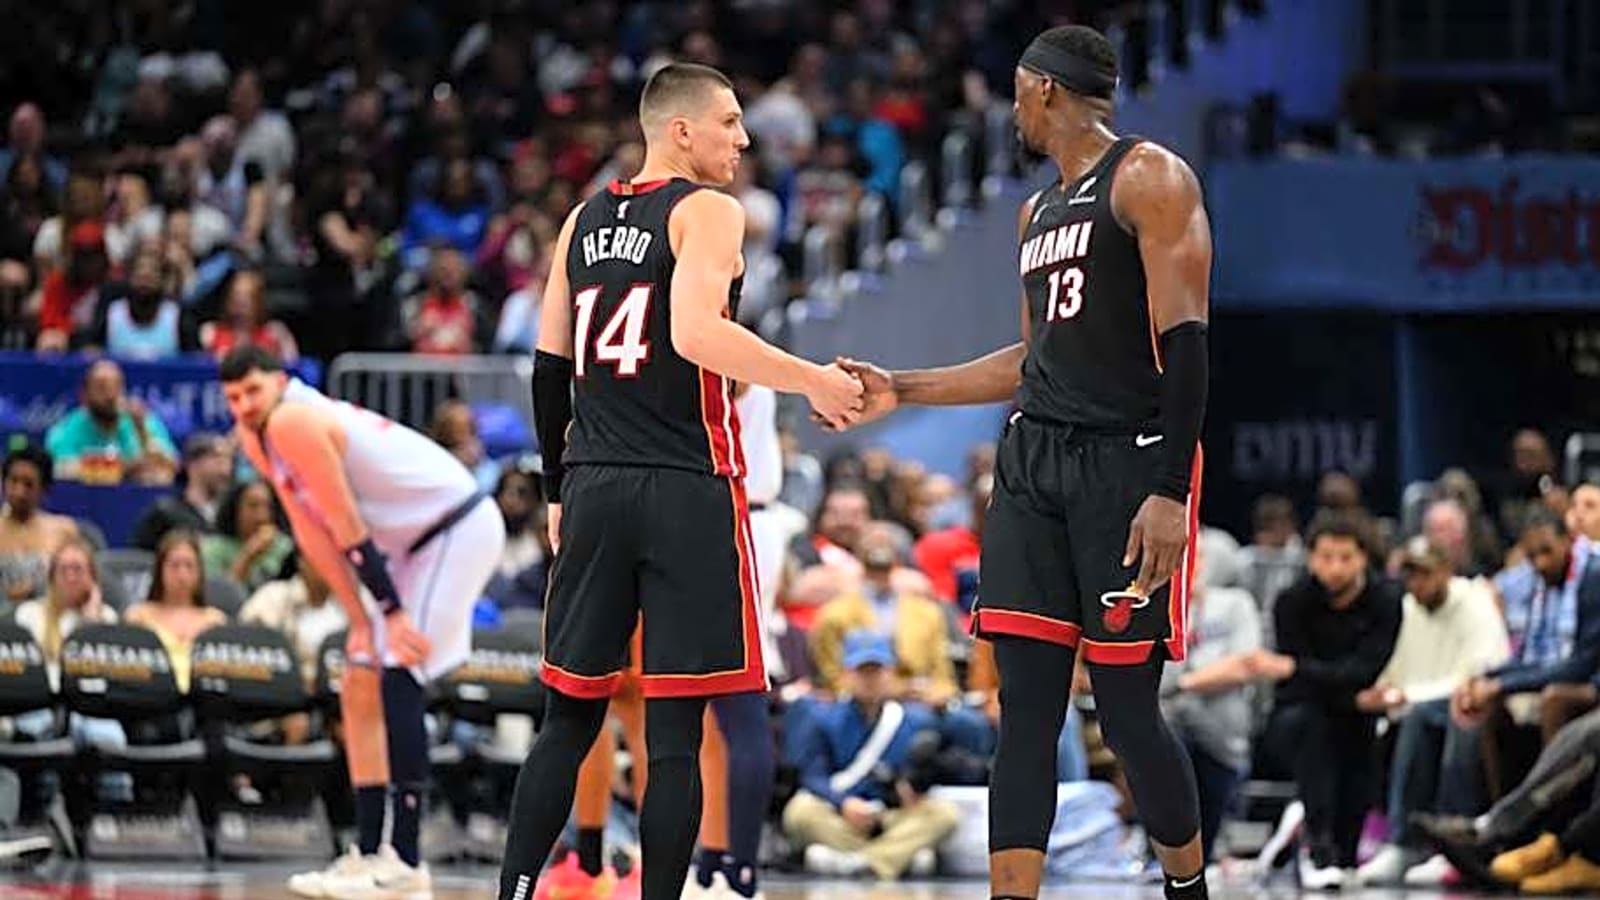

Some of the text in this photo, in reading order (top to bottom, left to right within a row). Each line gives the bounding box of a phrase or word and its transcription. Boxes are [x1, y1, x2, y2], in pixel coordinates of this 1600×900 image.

[582, 226, 653, 267] HERRO
[1020, 220, 1094, 277] MIAMI
[1046, 267, 1085, 322] 13
[573, 282, 655, 378] 14
